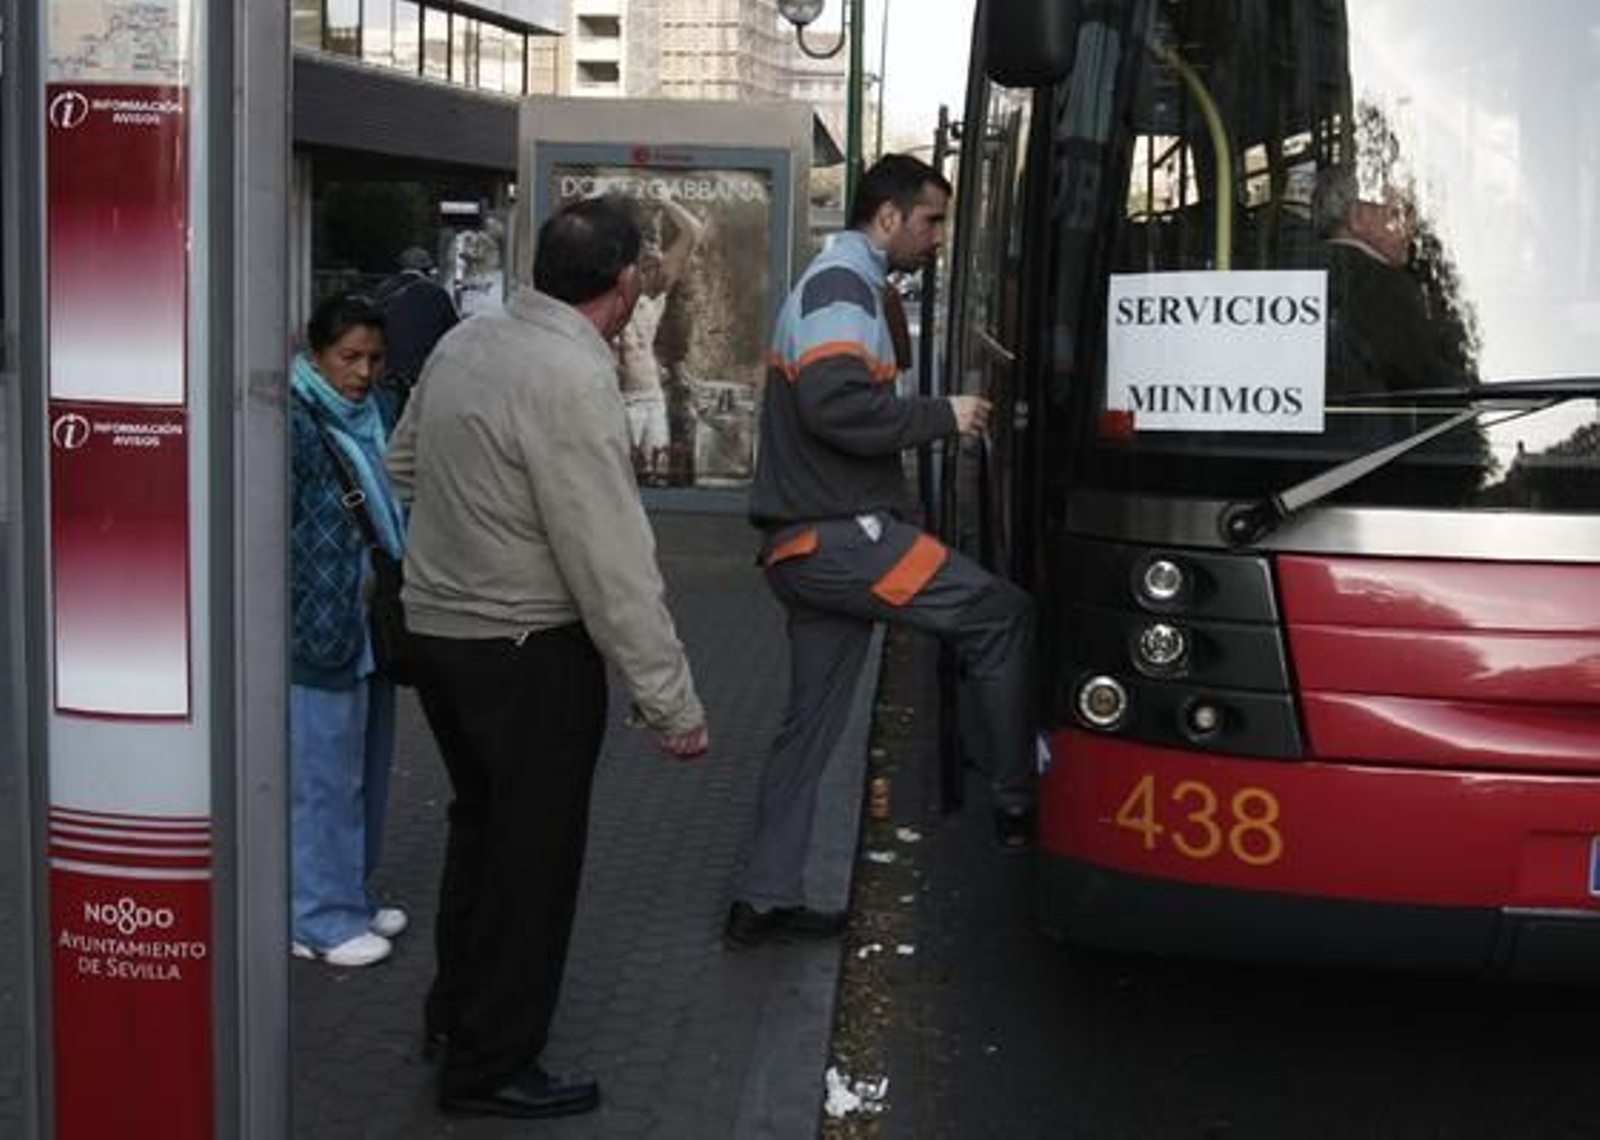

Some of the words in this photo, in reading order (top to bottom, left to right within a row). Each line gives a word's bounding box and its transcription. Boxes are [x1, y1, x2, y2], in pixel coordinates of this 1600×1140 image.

[1115, 295, 1321, 326] SERVICIOS
[1128, 384, 1304, 415] MINIMOS
[1115, 774, 1283, 866] 438
[59, 928, 206, 960] AYUNTAMIENTO
[78, 956, 101, 975] DE
[106, 957, 182, 981] SEVILLA
